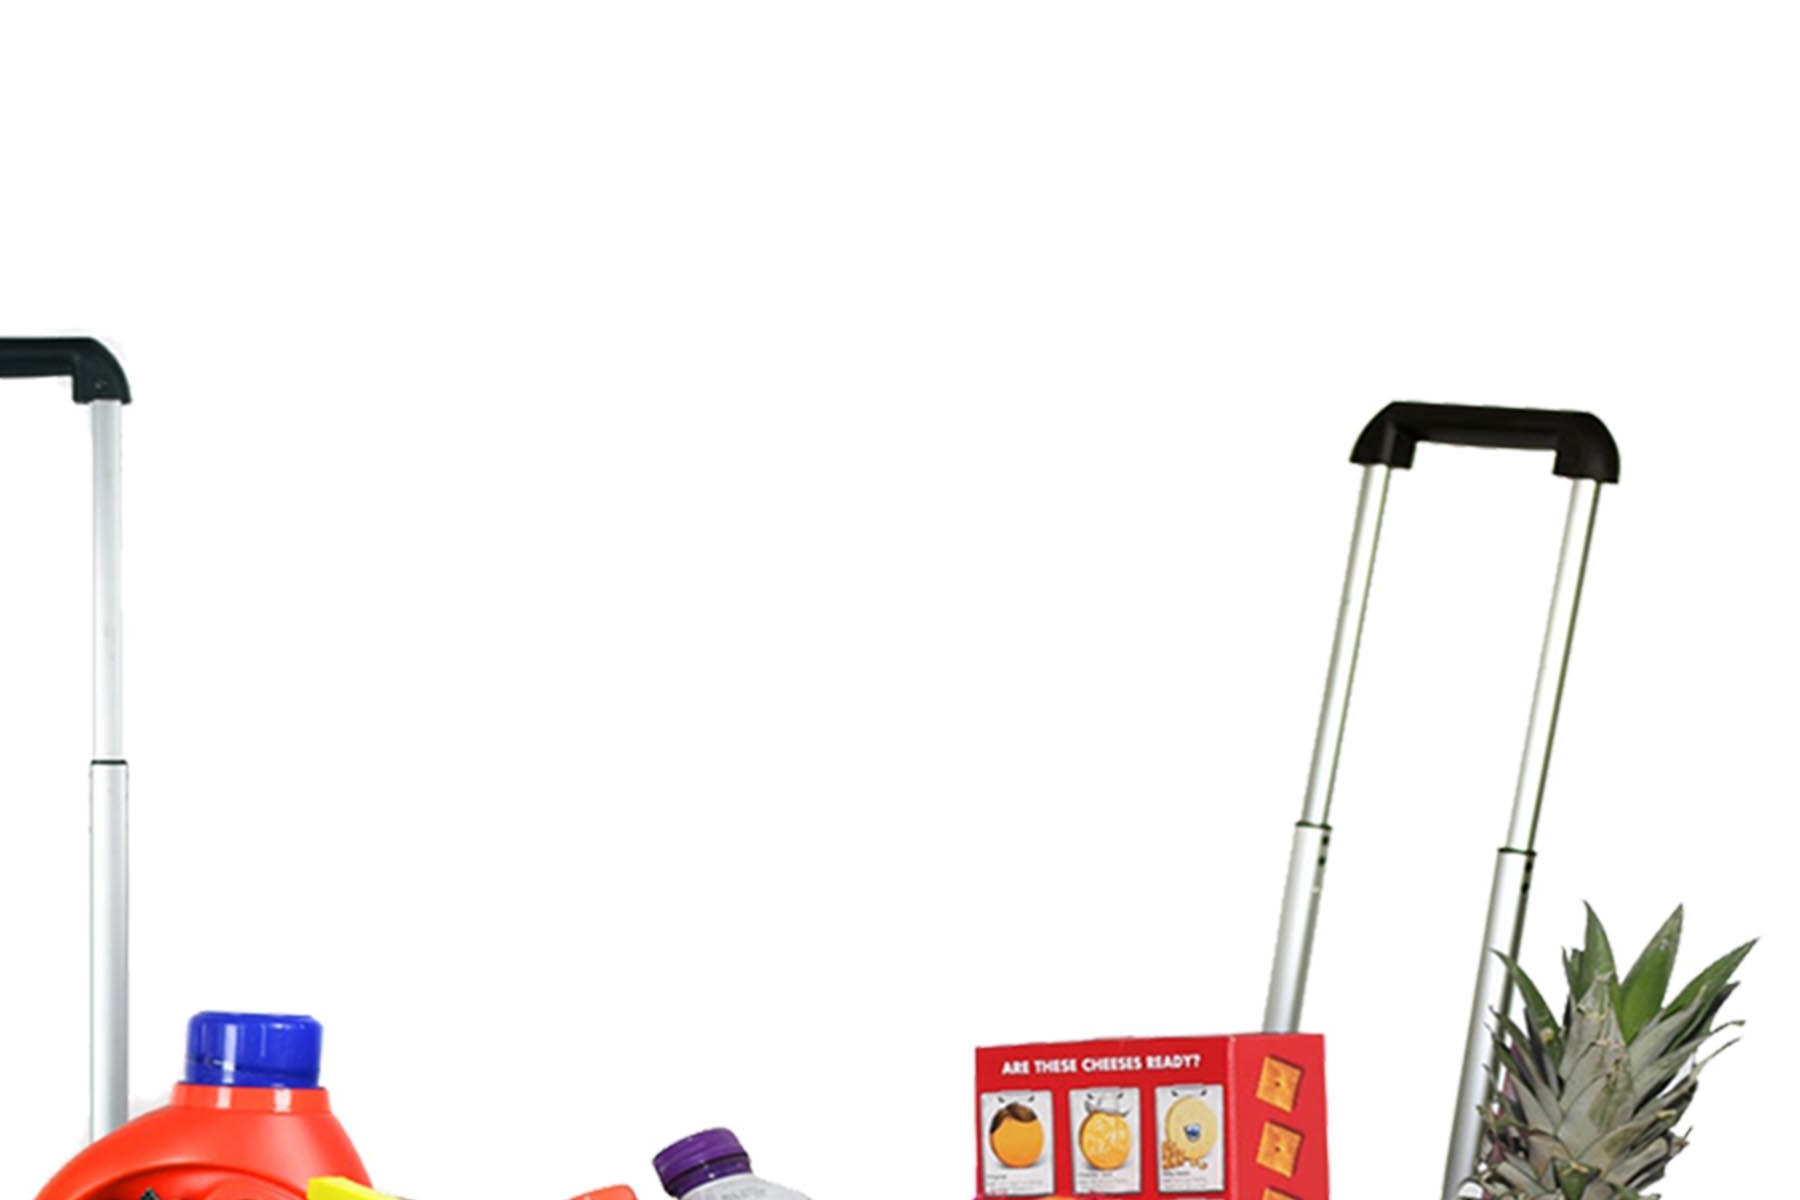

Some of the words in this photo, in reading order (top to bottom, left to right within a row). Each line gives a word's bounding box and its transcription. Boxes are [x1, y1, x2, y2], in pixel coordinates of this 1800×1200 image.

[1001, 1060, 1030, 1076] ARE
[1033, 1058, 1077, 1074] THESE
[1081, 1055, 1142, 1073] CHEESES
[1145, 1053, 1201, 1071] READY?
